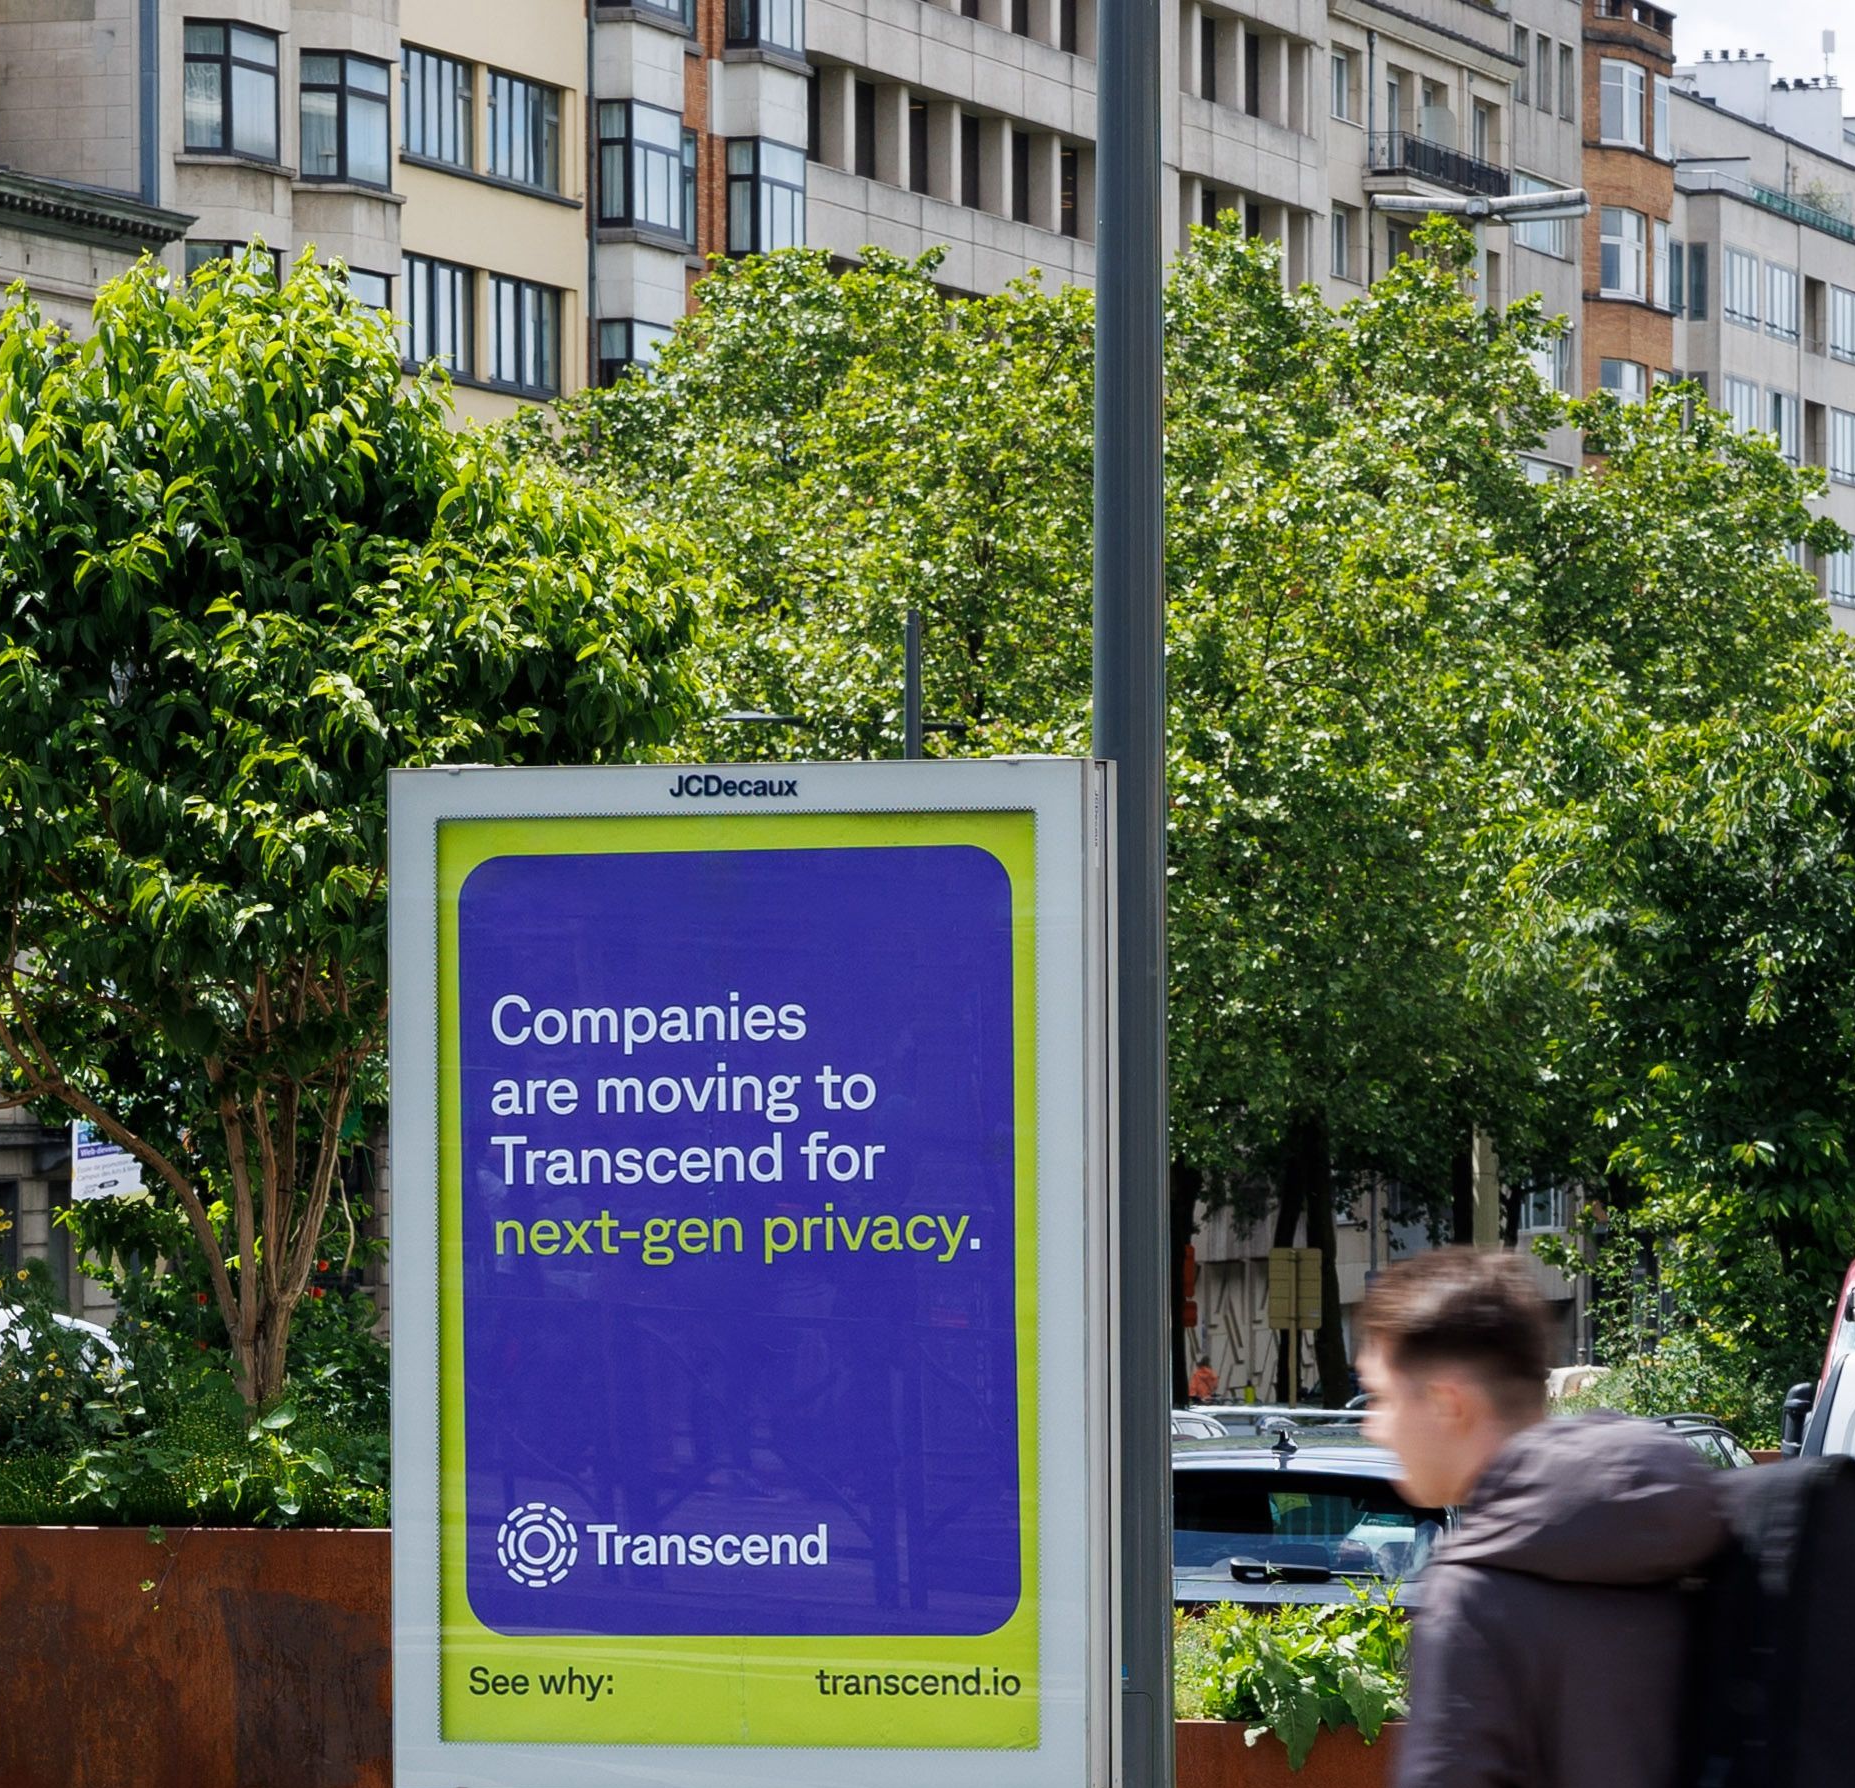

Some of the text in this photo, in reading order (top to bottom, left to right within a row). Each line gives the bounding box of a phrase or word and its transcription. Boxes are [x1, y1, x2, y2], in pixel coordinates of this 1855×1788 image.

[668, 774, 798, 798] JCDecaux
[490, 991, 807, 1055] Companies
[490, 1062, 877, 1123] are moving to
[490, 1130, 885, 1185] Transcend for
[495, 1202, 981, 1266] next-gen privacy.
[586, 1523, 829, 1567] Transcend
[468, 1666, 614, 1702] See why:
[815, 1666, 1022, 1697] transcend.io
